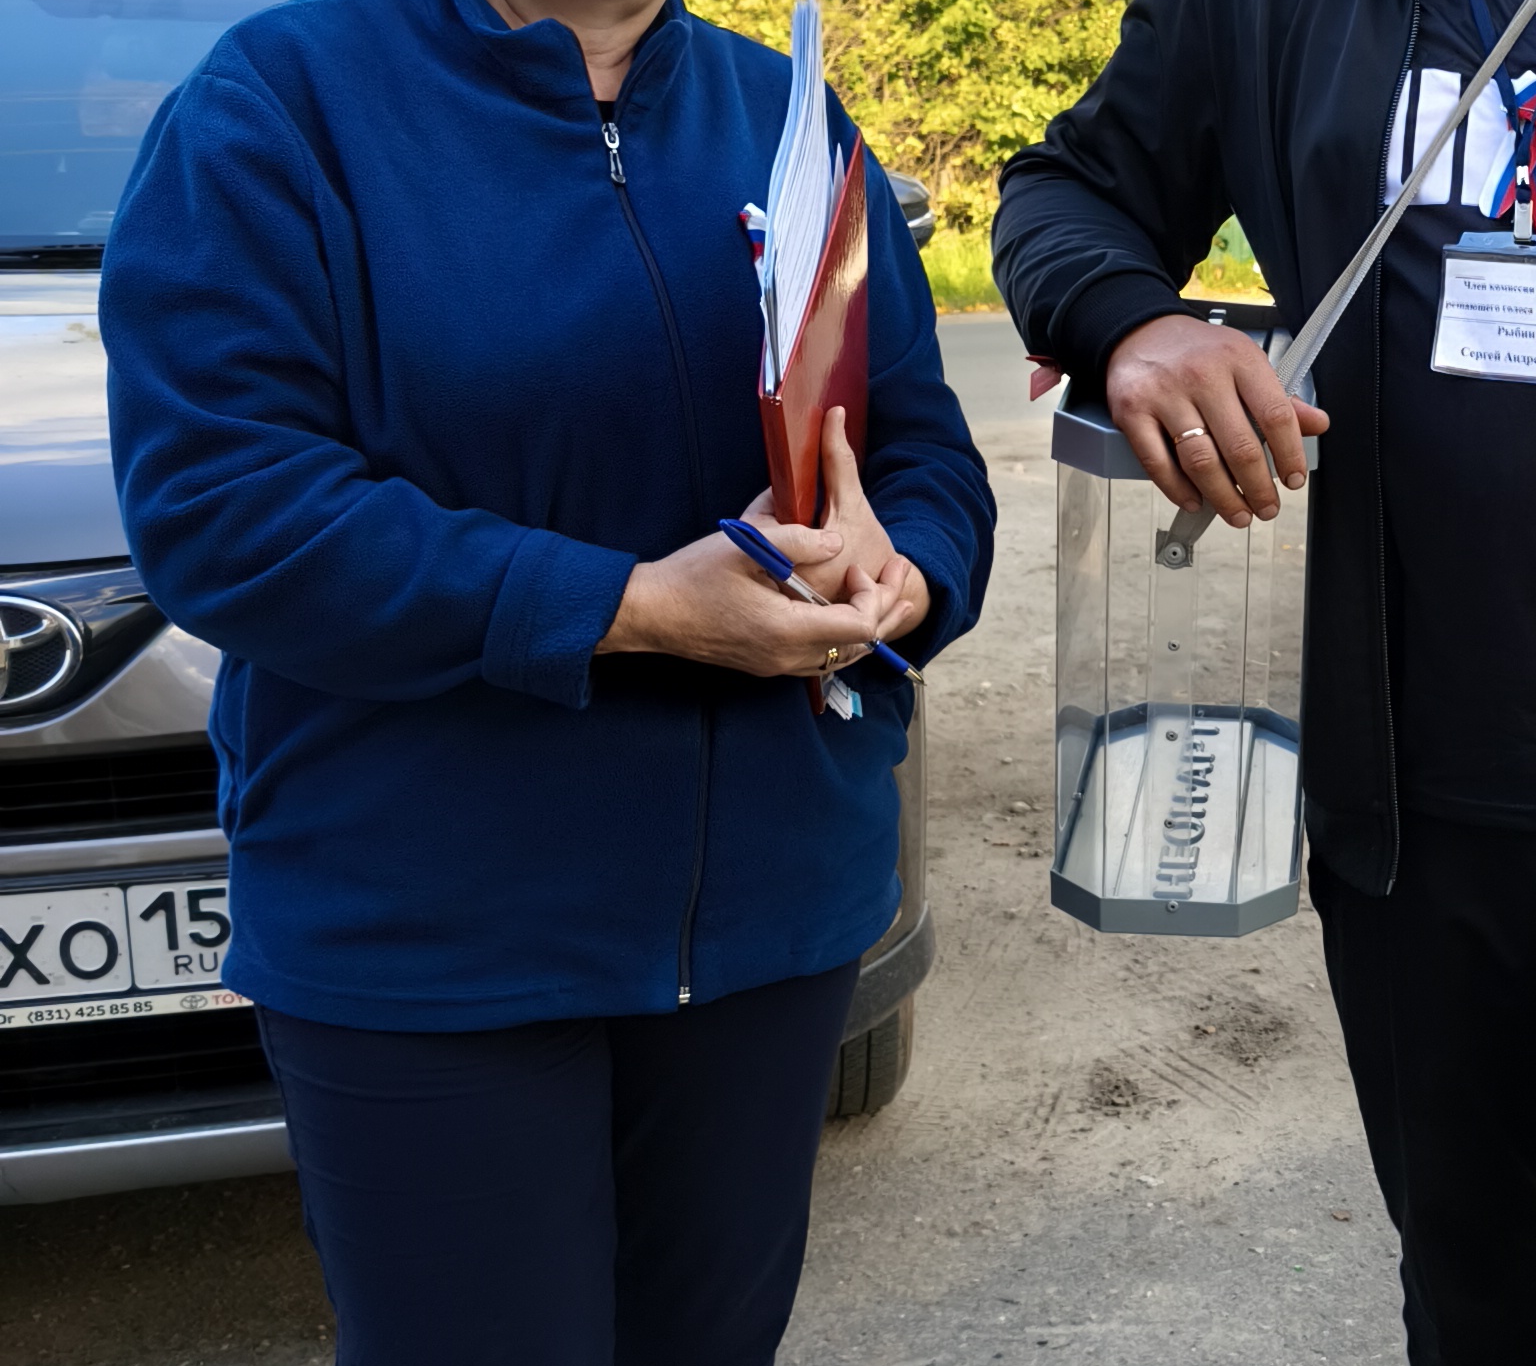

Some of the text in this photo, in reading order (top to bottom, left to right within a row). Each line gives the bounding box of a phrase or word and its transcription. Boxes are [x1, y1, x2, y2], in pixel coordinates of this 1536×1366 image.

[1463, 280, 1487, 291] Член
[1489, 283, 1535, 294] комиссии
[1502, 304, 1533, 315] голоса
[1497, 325, 1536, 339] Рыбин
[1460, 346, 1501, 362] Сергей
[139, 887, 232, 951] 15
[173, 952, 219, 976] RU
[211, 993, 251, 1006] TOY
[27, 1008, 71, 1024] (831)
[75, 1004, 106, 1018] 425
[109, 1002, 130, 1015] 85
[133, 1000, 154, 1013] 85
